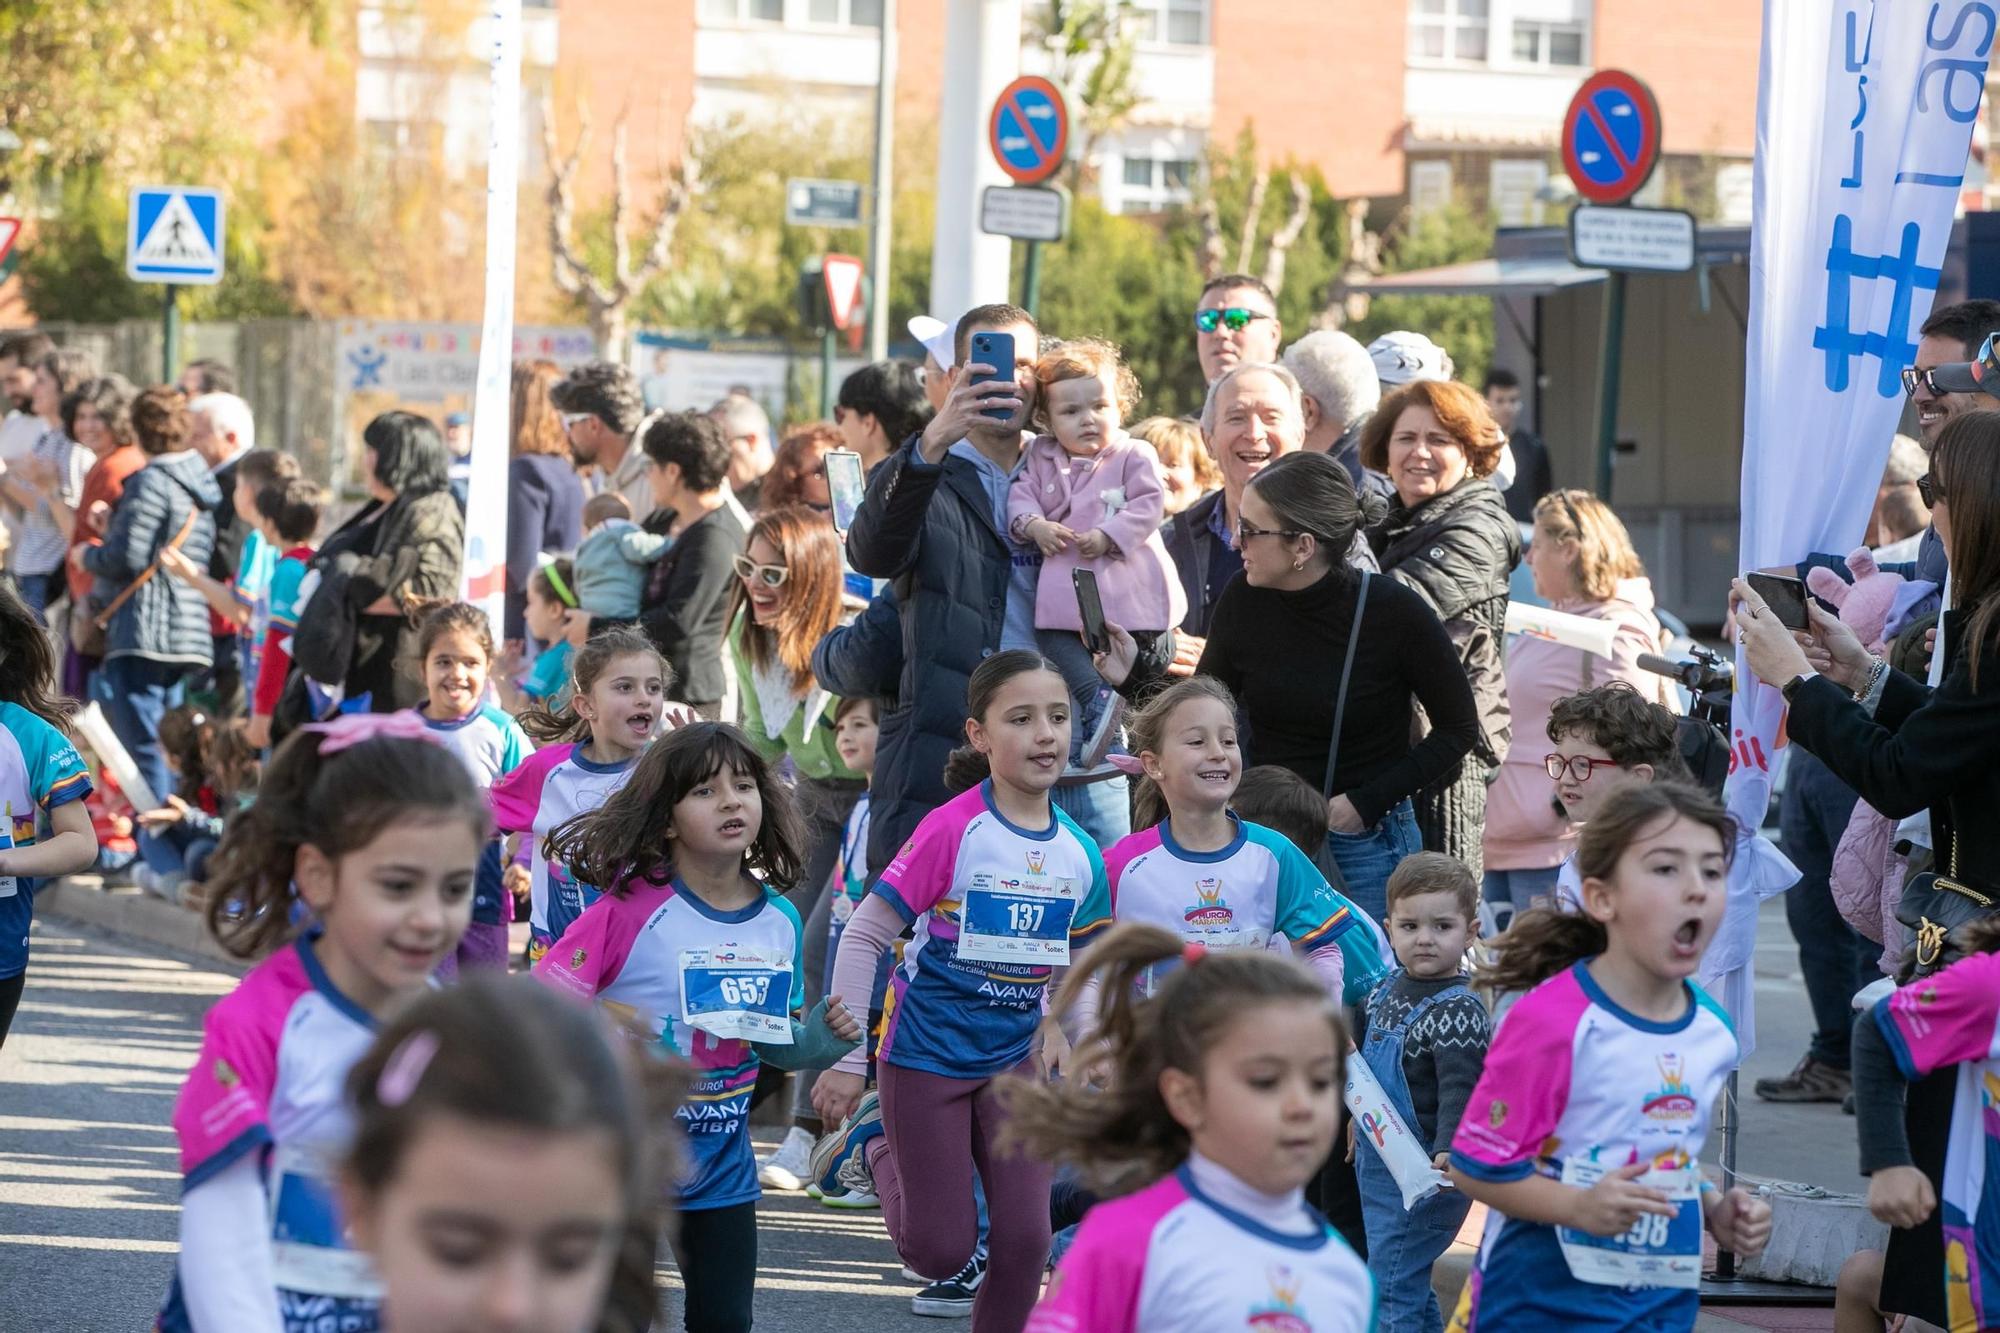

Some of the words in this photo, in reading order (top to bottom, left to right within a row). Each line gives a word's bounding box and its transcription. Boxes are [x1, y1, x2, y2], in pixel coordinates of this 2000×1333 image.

[1007, 902, 1045, 932] 137
[947, 961, 965, 972] Costa
[997, 964, 1031, 975] MURCIA
[720, 976, 771, 1006] 653
[687, 1119, 740, 1134] FIBR
[1613, 1210, 1671, 1248] 98
